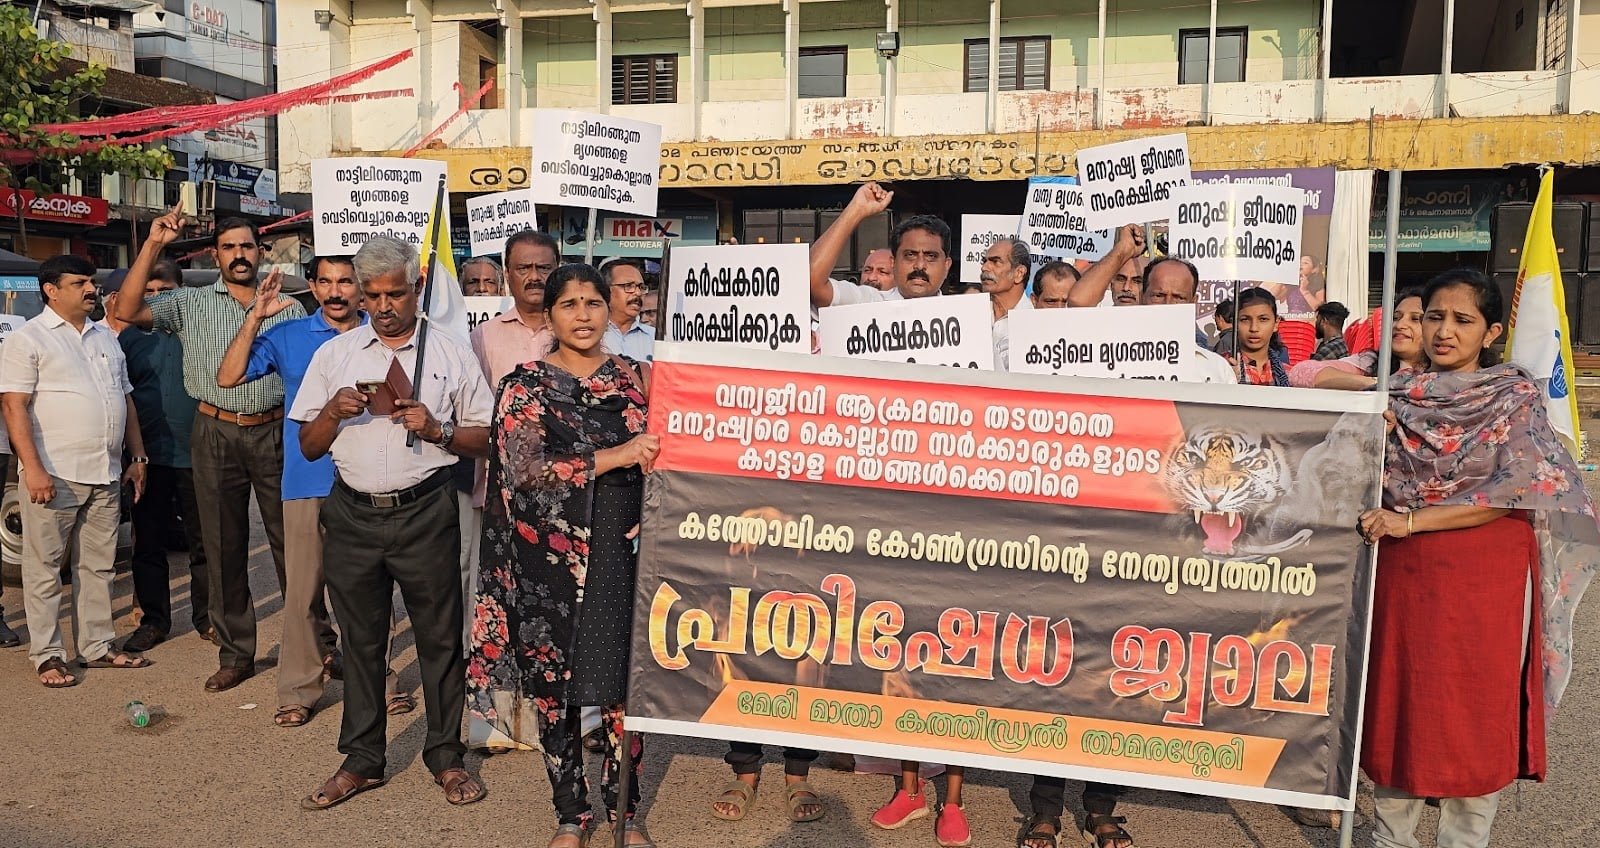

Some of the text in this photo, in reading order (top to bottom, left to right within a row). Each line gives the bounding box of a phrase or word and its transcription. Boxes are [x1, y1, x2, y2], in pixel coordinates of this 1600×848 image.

[561, 120, 641, 143] നാട്ടിലിറങ്ങുന്ന
[574, 143, 628, 163] മൃഗങ്ങളെ
[661, 148, 680, 157] ാമ
[1086, 146, 1185, 182] മനുഷ്യ ജീവനെ
[336, 166, 422, 184] നാട്ടിലിറങ്ങുന്ന
[541, 160, 652, 187] വെടിവെച്ചുകൊല്ലാൻ
[351, 190, 409, 207] മൃഗങ്ങളെ
[497, 199, 530, 219] ജീവനെ
[560, 183, 635, 204] ഉത്തരവിടുക.
[1033, 188, 1053, 208] വന്യ
[1091, 179, 1186, 211] സംരക്ഷിക്ക
[322, 208, 430, 227] വെടിവെച്ചുകൊല്ലാ
[1243, 195, 1297, 227] ജീവനെ
[619, 241, 662, 249] FOOTWEAR
[1031, 232, 1098, 255] തുരത്തുക.
[684, 262, 780, 297] കർഷകരെ
[672, 304, 801, 350] സംരക്ഷിക്കുക
[847, 316, 961, 355] കർഷകരെ
[1025, 338, 1180, 371] കാട്ടിലെ മൃഗങ്ങളെ
[715, 382, 1115, 438] വന്യജീവി ആക്രമണം തടയാതെ
[667, 410, 1161, 477] മനുഷ്യരെ കൊല്ലുന്ന സർക്കാരുകളുടെ
[737, 447, 1080, 499] കാട്ടാള നയങ്ങൾക്കെതിരെ
[678, 511, 855, 554] കത്തോലിക്ക
[1101, 548, 1318, 597] നേതൃത്വത്തിൽ
[648, 573, 1336, 726] പ്രതിഷേധ ജ്വാല
[737, 688, 1245, 777] മേരി മാതാ കത്തീഡ്രൽ താമരശ്ശേരി
